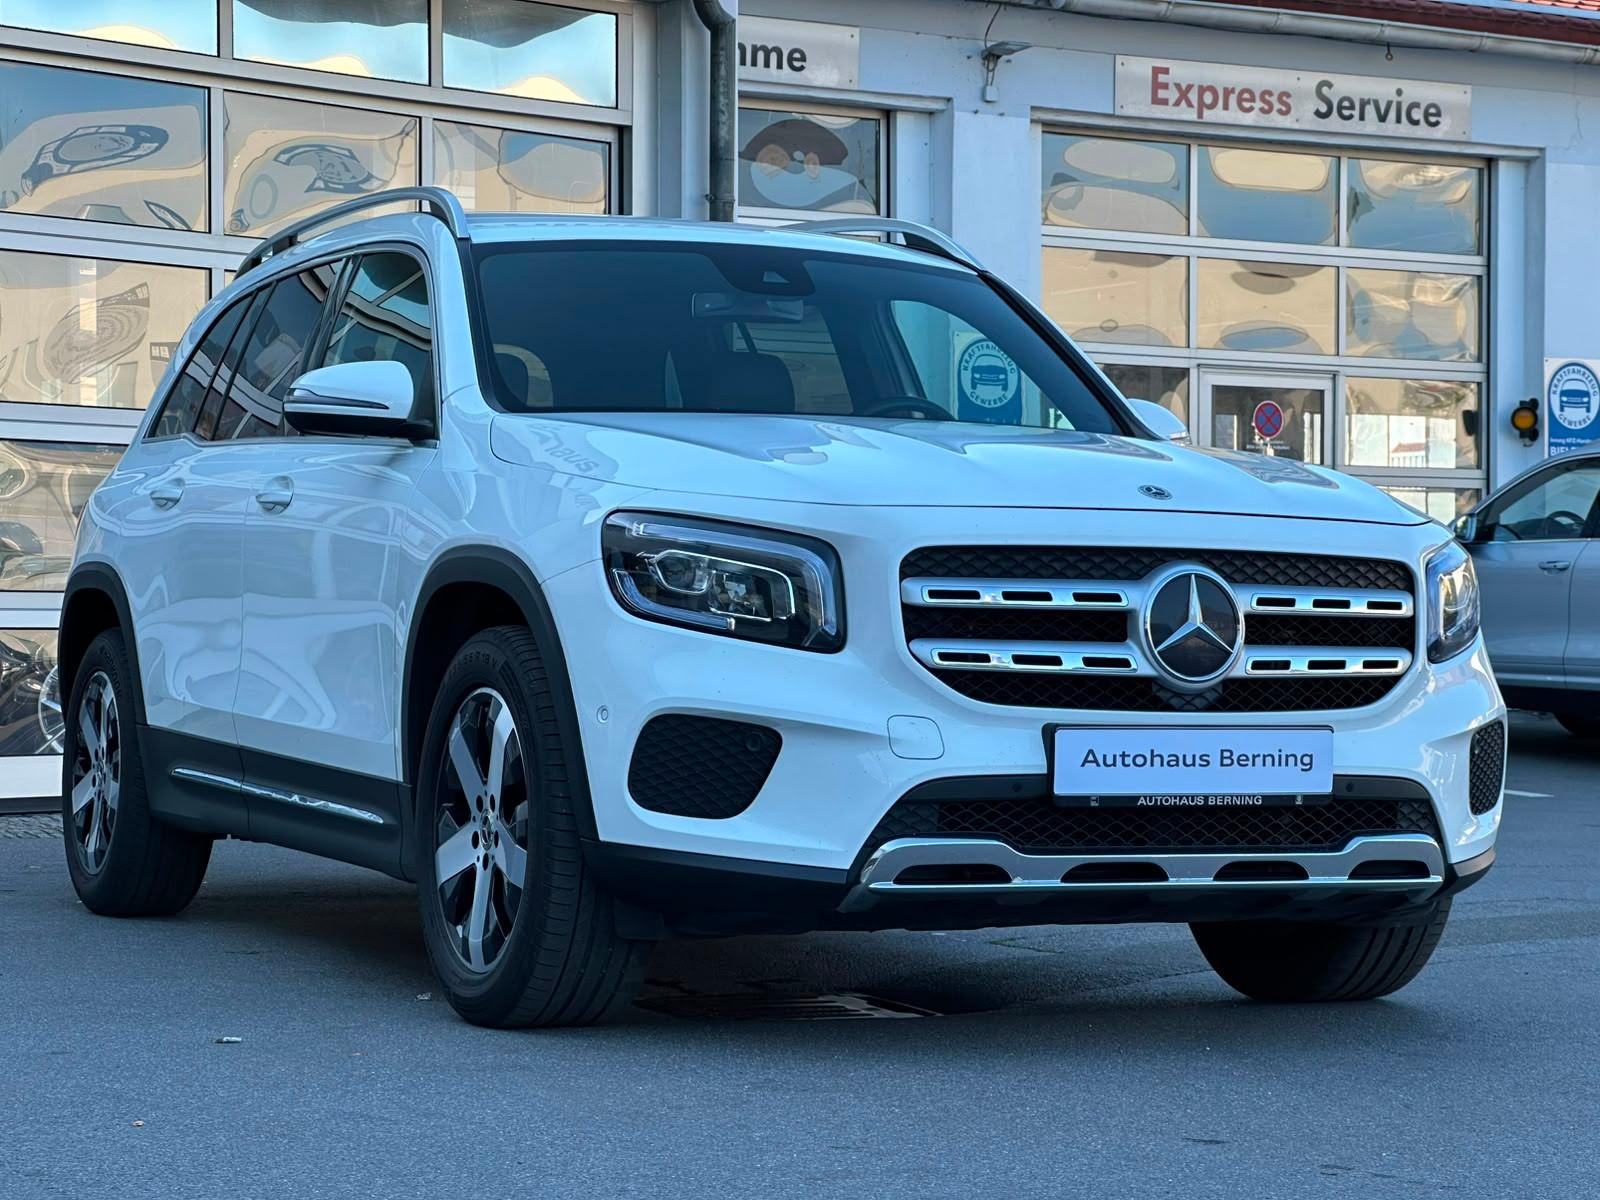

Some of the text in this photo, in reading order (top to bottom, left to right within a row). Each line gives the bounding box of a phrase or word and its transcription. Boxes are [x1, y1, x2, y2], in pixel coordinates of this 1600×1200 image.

[1151, 66, 1442, 128] Express Service
[1552, 368, 1598, 397] KRAFTFAHRZEUG
[1558, 413, 1591, 428] GEWERBE
[1080, 748, 1314, 772] Autohaus Berning
[1137, 795, 1263, 806] AUTOHAUS BERNING
